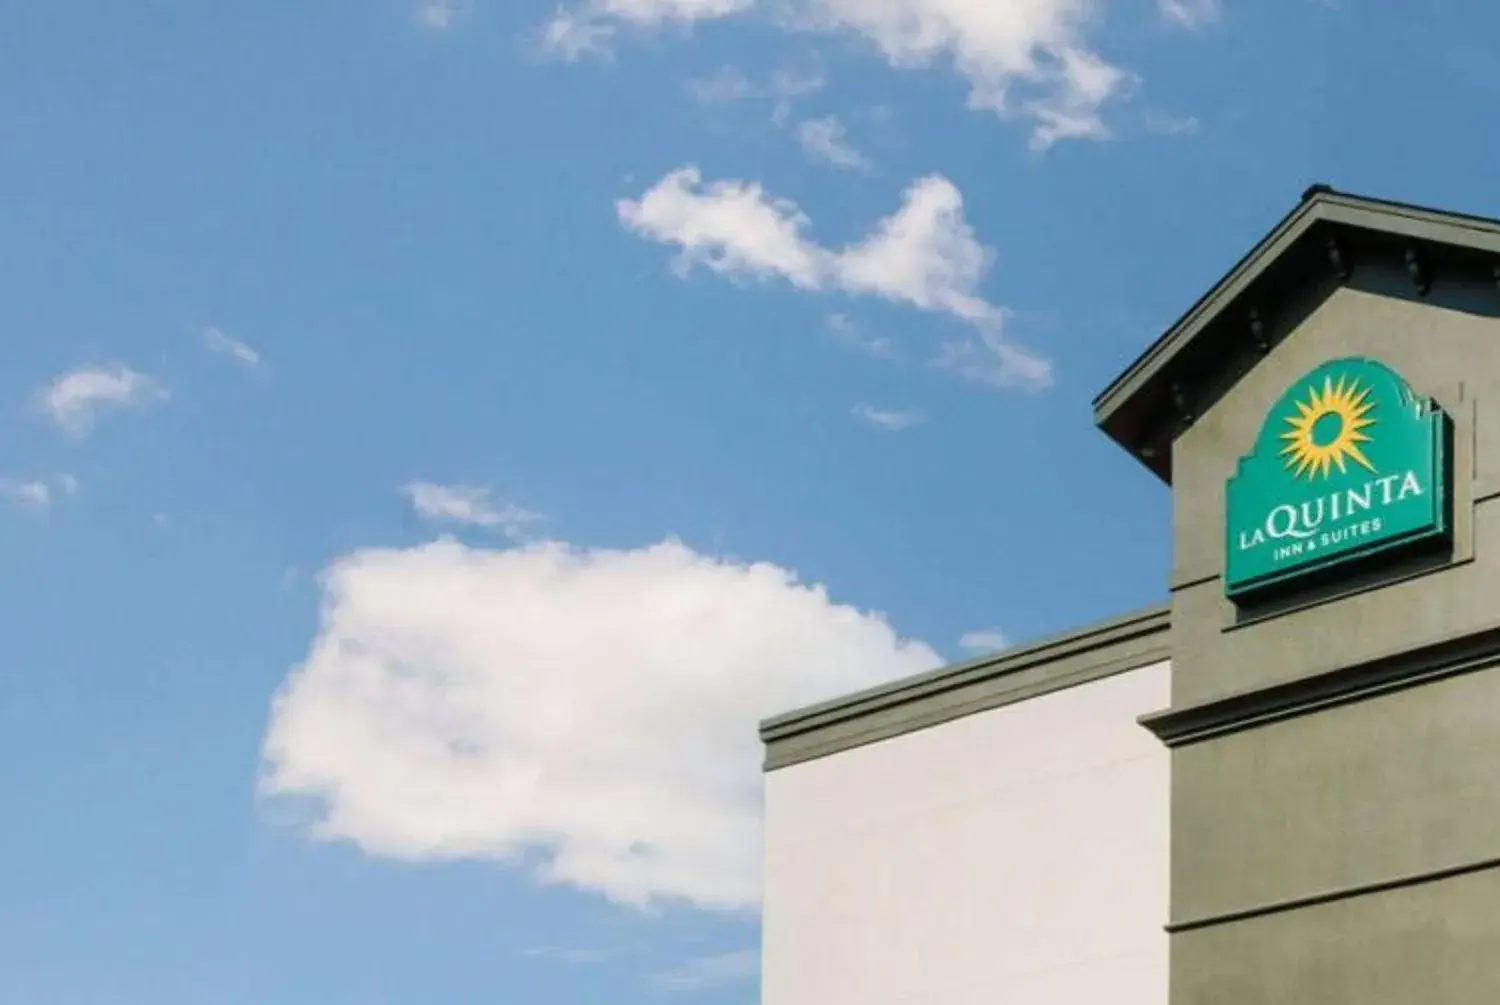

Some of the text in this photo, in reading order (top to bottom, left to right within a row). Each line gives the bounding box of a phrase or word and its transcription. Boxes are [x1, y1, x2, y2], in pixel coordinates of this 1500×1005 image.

[1240, 469, 1424, 550] LA QUINTA
[1273, 542, 1303, 561] INN
[1321, 517, 1382, 546] SUITES
